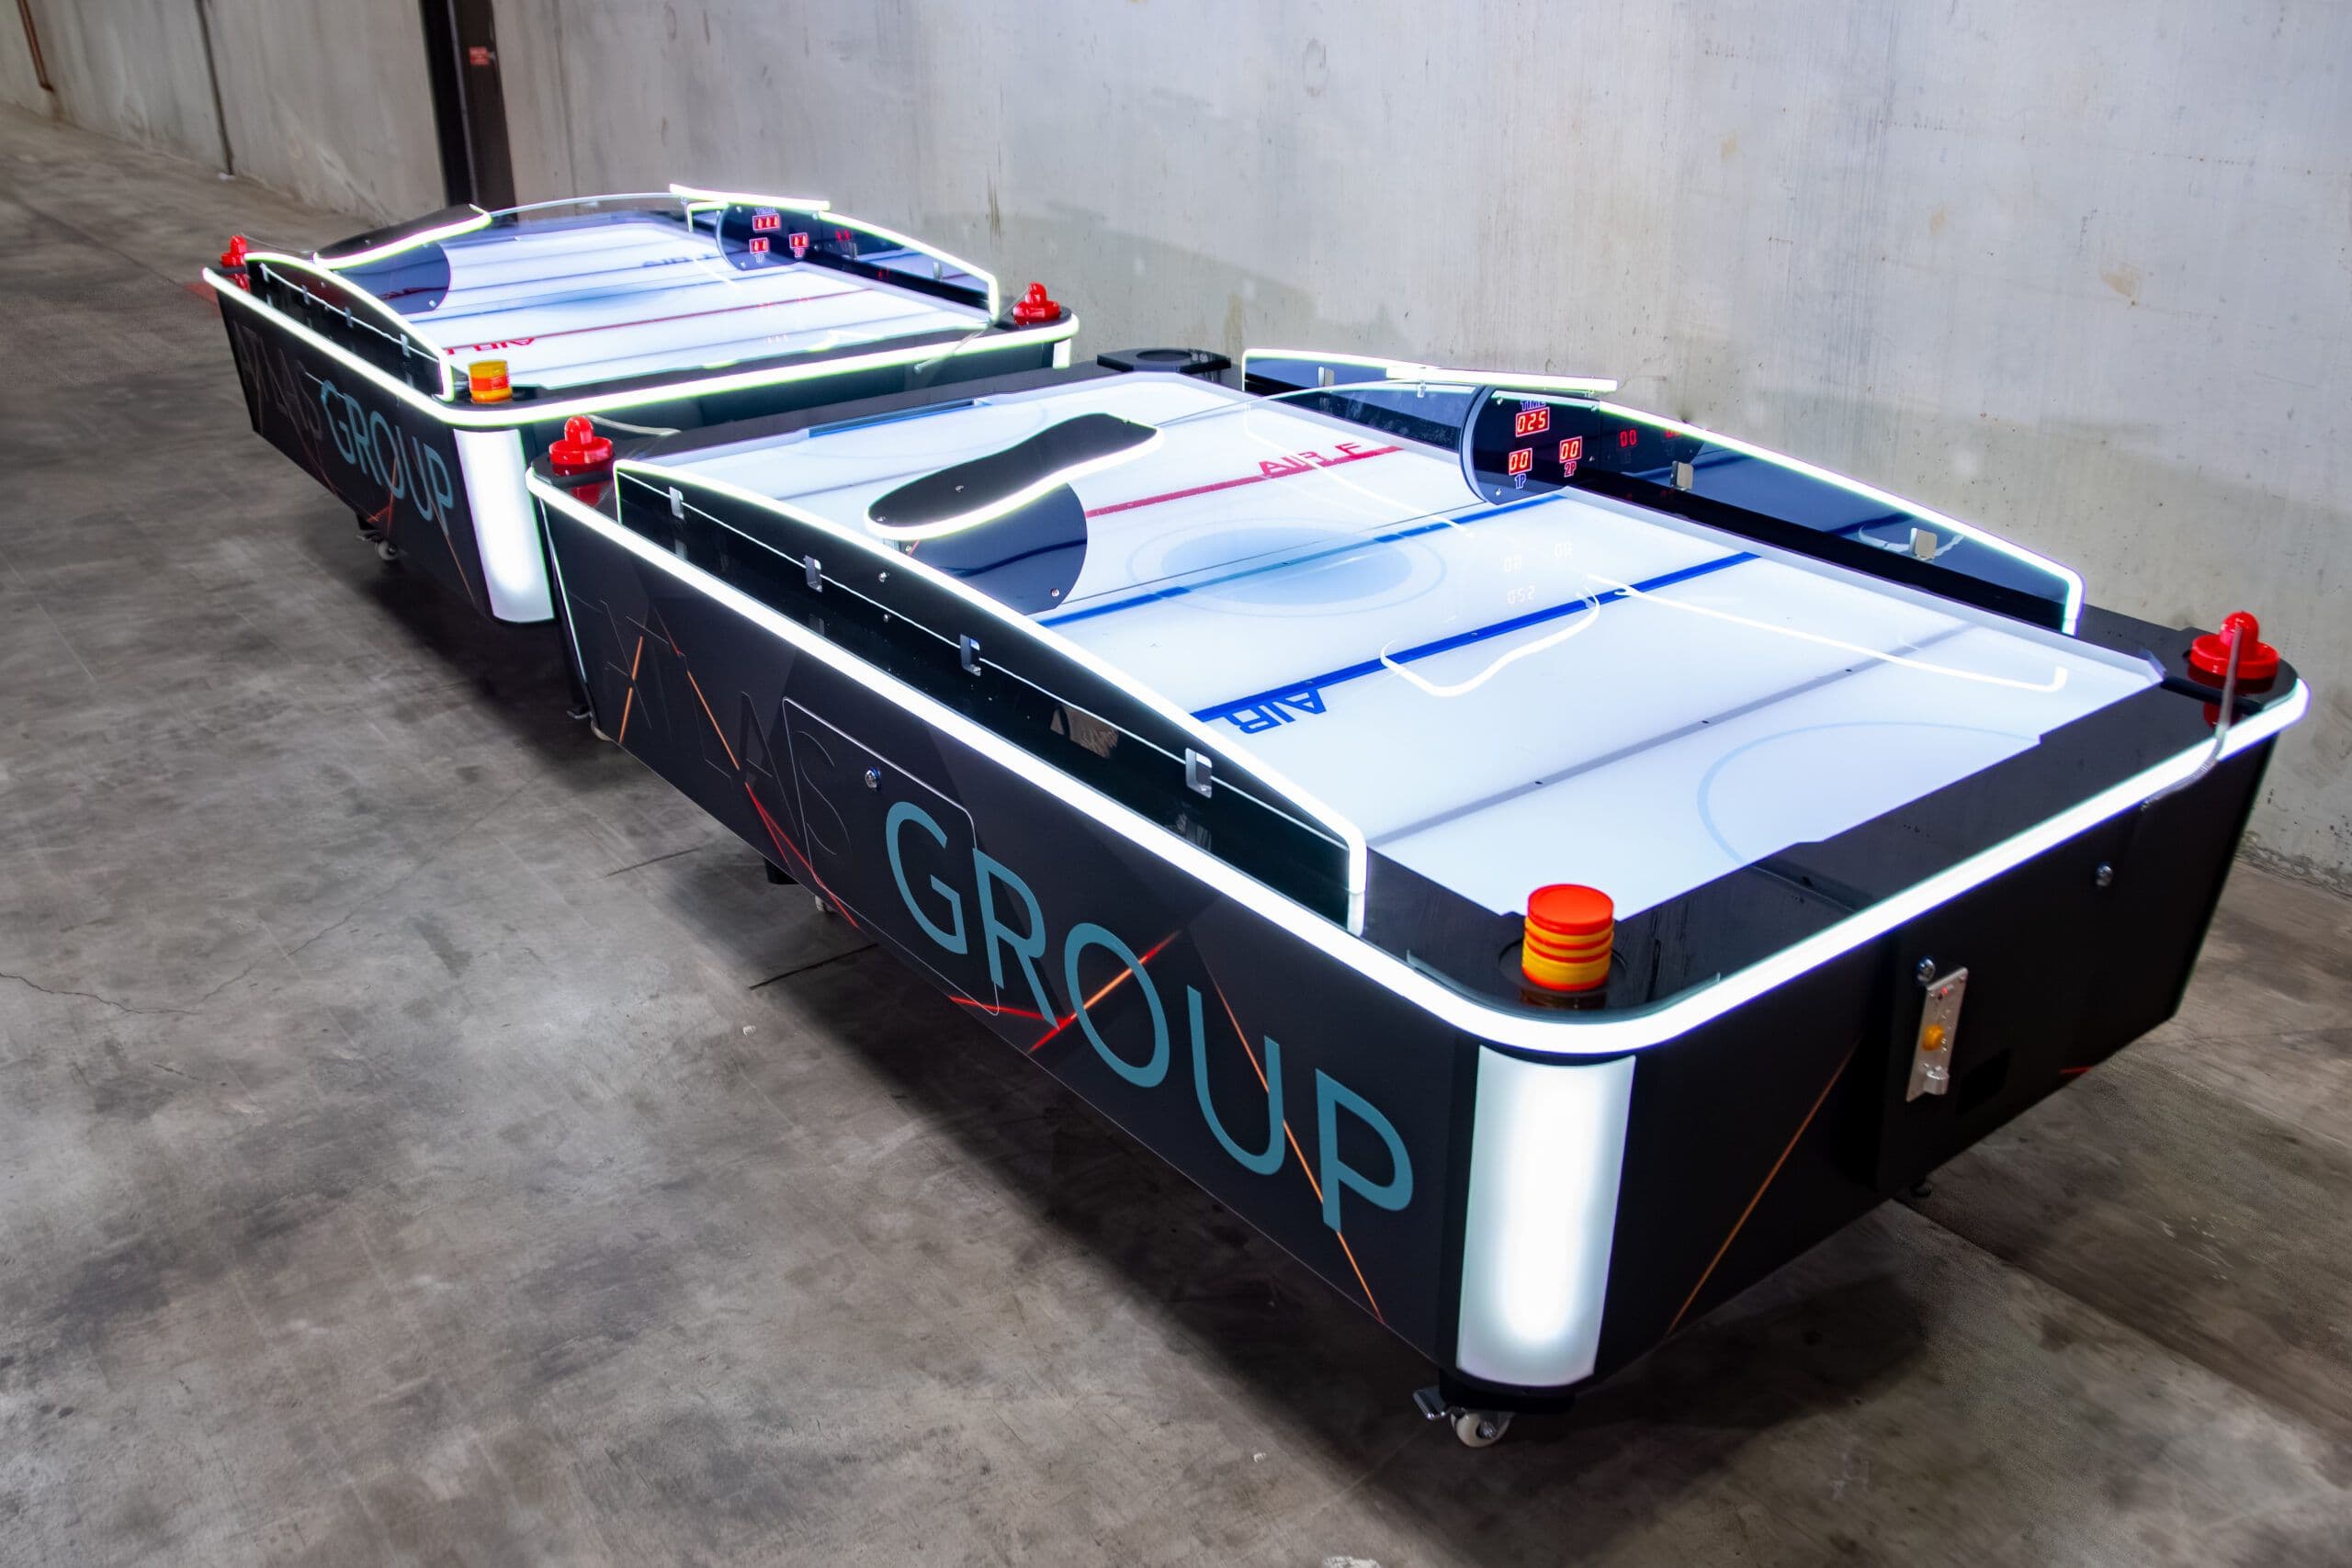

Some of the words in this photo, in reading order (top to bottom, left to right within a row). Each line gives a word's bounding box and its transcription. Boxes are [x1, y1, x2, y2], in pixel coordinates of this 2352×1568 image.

[1516, 410, 1547, 434] 025
[320, 378, 456, 536] GROUP
[1509, 450, 1530, 472] 00
[1561, 438, 1580, 460] 00
[1259, 451, 1329, 477] AIR
[1564, 460, 1577, 478] 2P
[1514, 474, 1527, 490] 1P
[1222, 684, 1327, 735] AIR
[886, 801, 1413, 1233] GROUP
